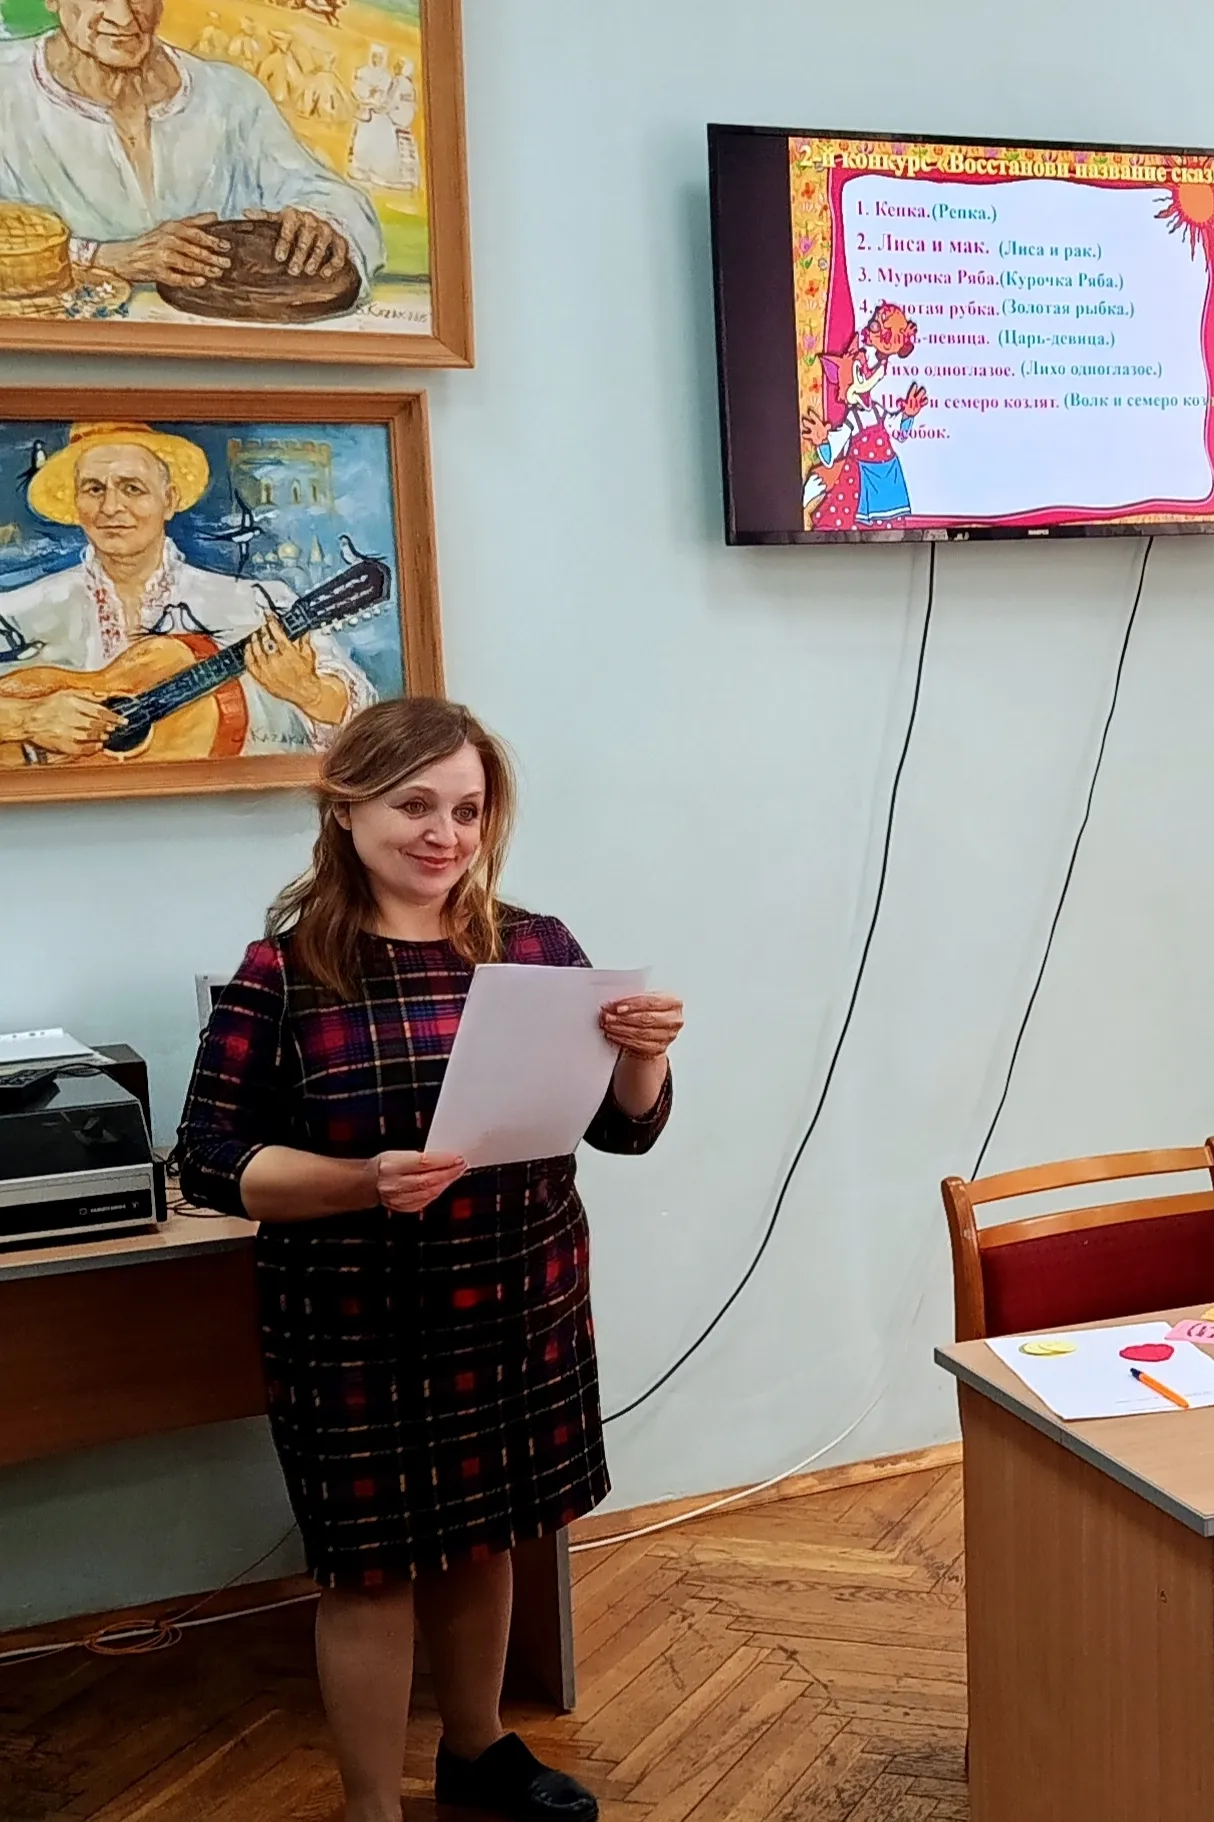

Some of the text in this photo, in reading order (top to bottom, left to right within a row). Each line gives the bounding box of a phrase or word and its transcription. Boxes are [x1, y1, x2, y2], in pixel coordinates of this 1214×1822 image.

[842, 153, 932, 177] конкурс
[1075, 163, 1167, 183] название
[857, 200, 869, 216] 1.
[856, 232, 1102, 261] 2. Лиса и мак. (Лиса и рак.)
[857, 266, 872, 283] 3.
[877, 267, 952, 287] Мурочка
[1078, 271, 1124, 290] Ряба.)
[858, 299, 873, 314] 4.
[1075, 301, 1135, 319] рыбка.)
[998, 329, 1115, 348] (Царь-девица.)
[885, 360, 1163, 379] ихо одноглазое. (Лихо одноглазое.)
[930, 398, 939, 409] и
[944, 397, 999, 413] семеро
[1004, 397, 1059, 409] козлят.
[1064, 392, 1108, 409] (Волк
[1113, 396, 1122, 407] и
[1127, 395, 1179, 410] семеро
